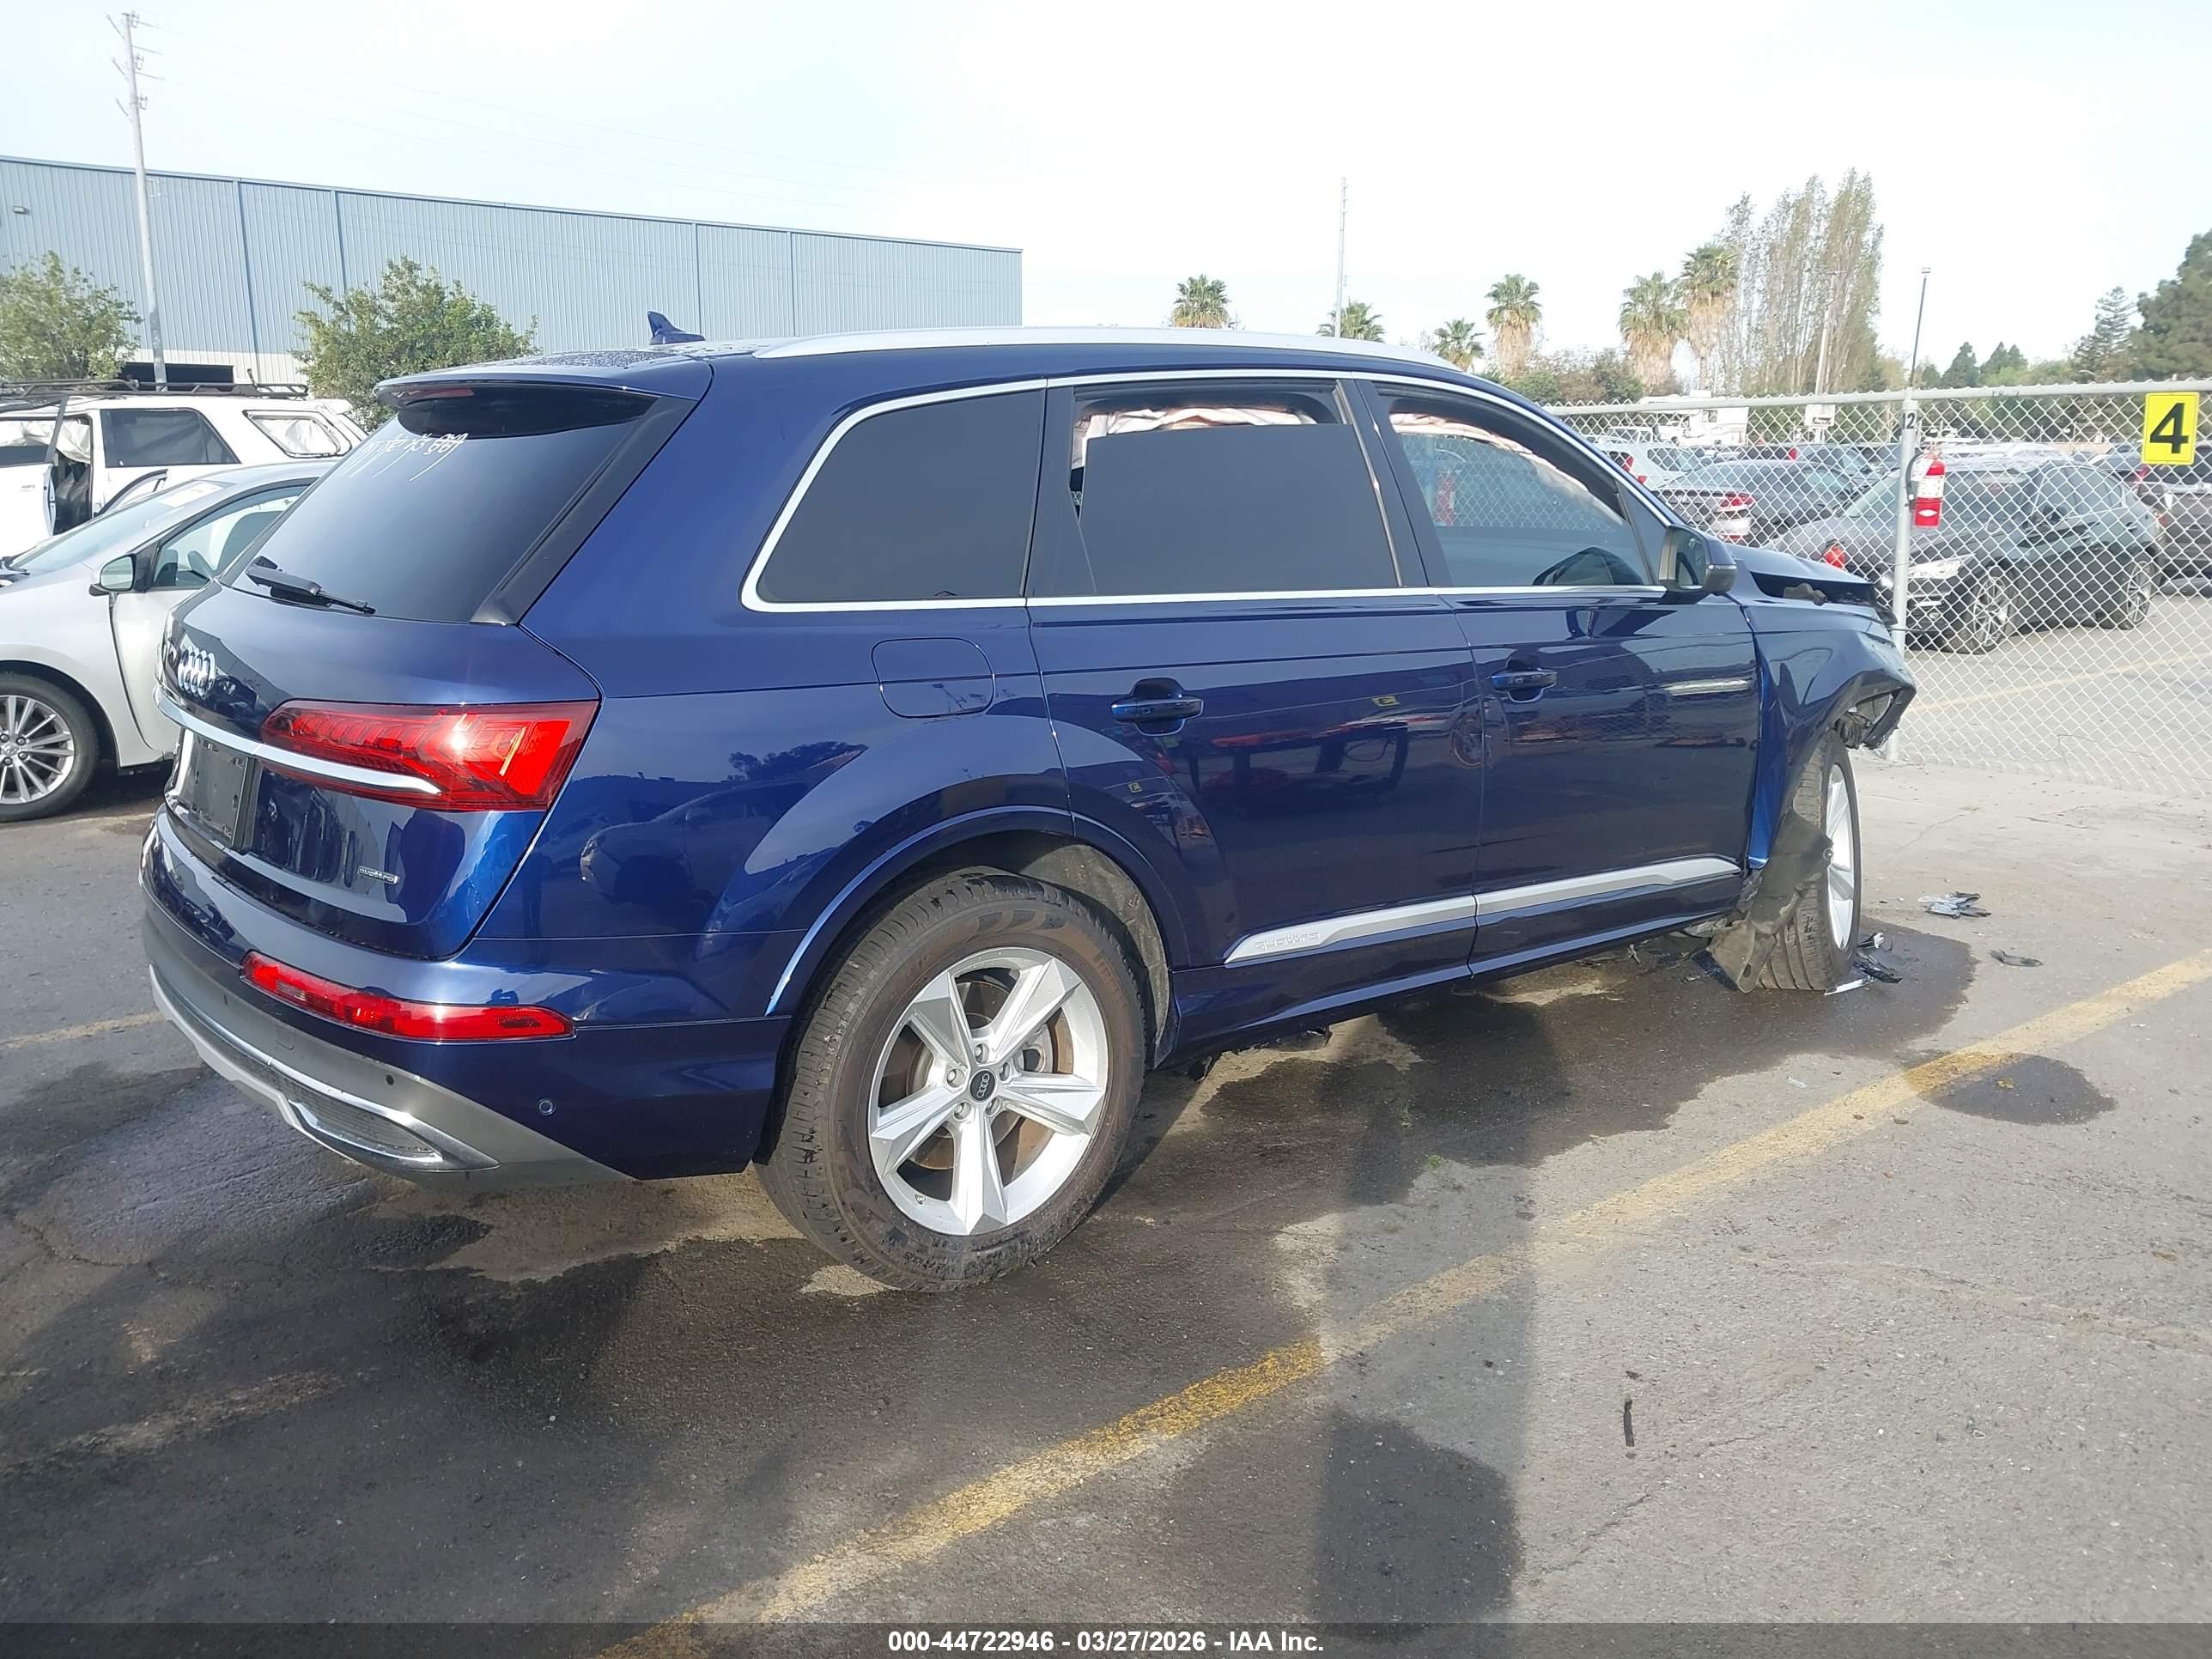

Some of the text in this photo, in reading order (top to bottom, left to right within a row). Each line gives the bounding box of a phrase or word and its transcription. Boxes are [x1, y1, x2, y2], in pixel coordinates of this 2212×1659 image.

[1902, 412, 1917, 429] 12
[2149, 402, 2190, 454] 4
[1255, 933, 1321, 951] quattro
